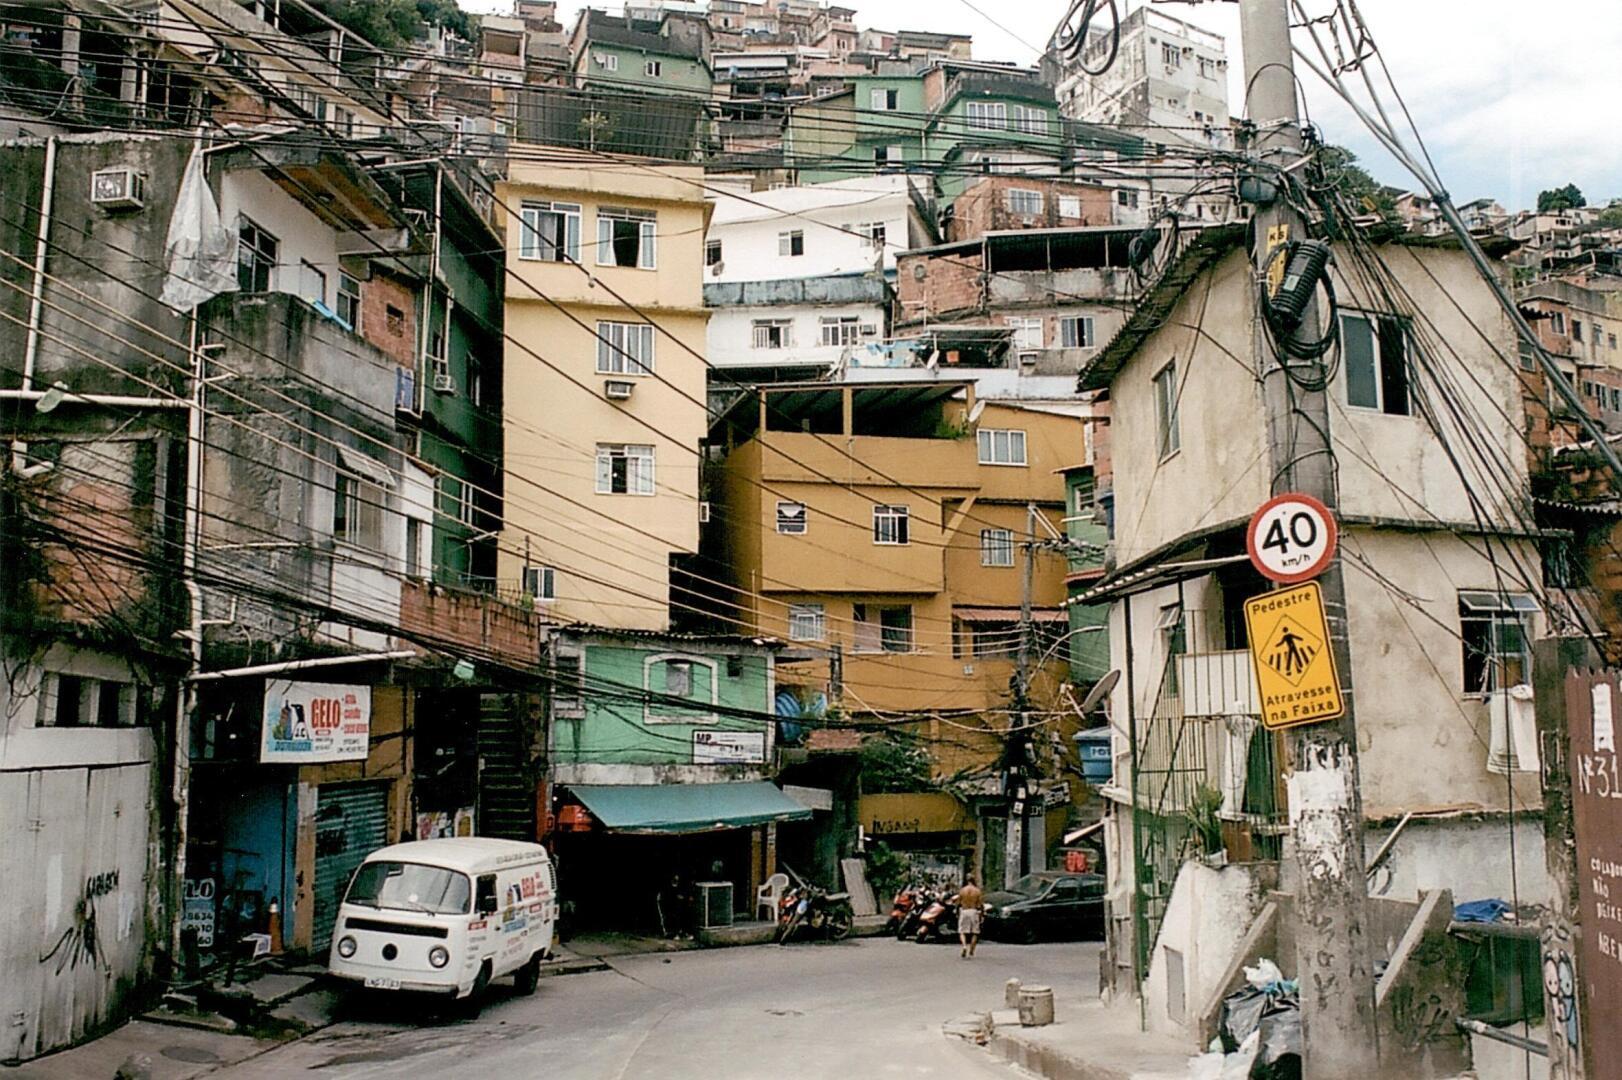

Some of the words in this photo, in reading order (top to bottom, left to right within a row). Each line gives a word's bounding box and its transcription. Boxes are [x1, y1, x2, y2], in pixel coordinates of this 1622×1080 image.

[1262, 511, 1317, 554] 40
[1282, 553, 1311, 567] km/h
[1252, 592, 1311, 615] Pedestre
[1266, 685, 1332, 707] Atravesse
[311, 698, 342, 729] GELO
[1271, 710, 1288, 722] na
[1292, 701, 1335, 717] Faixa
